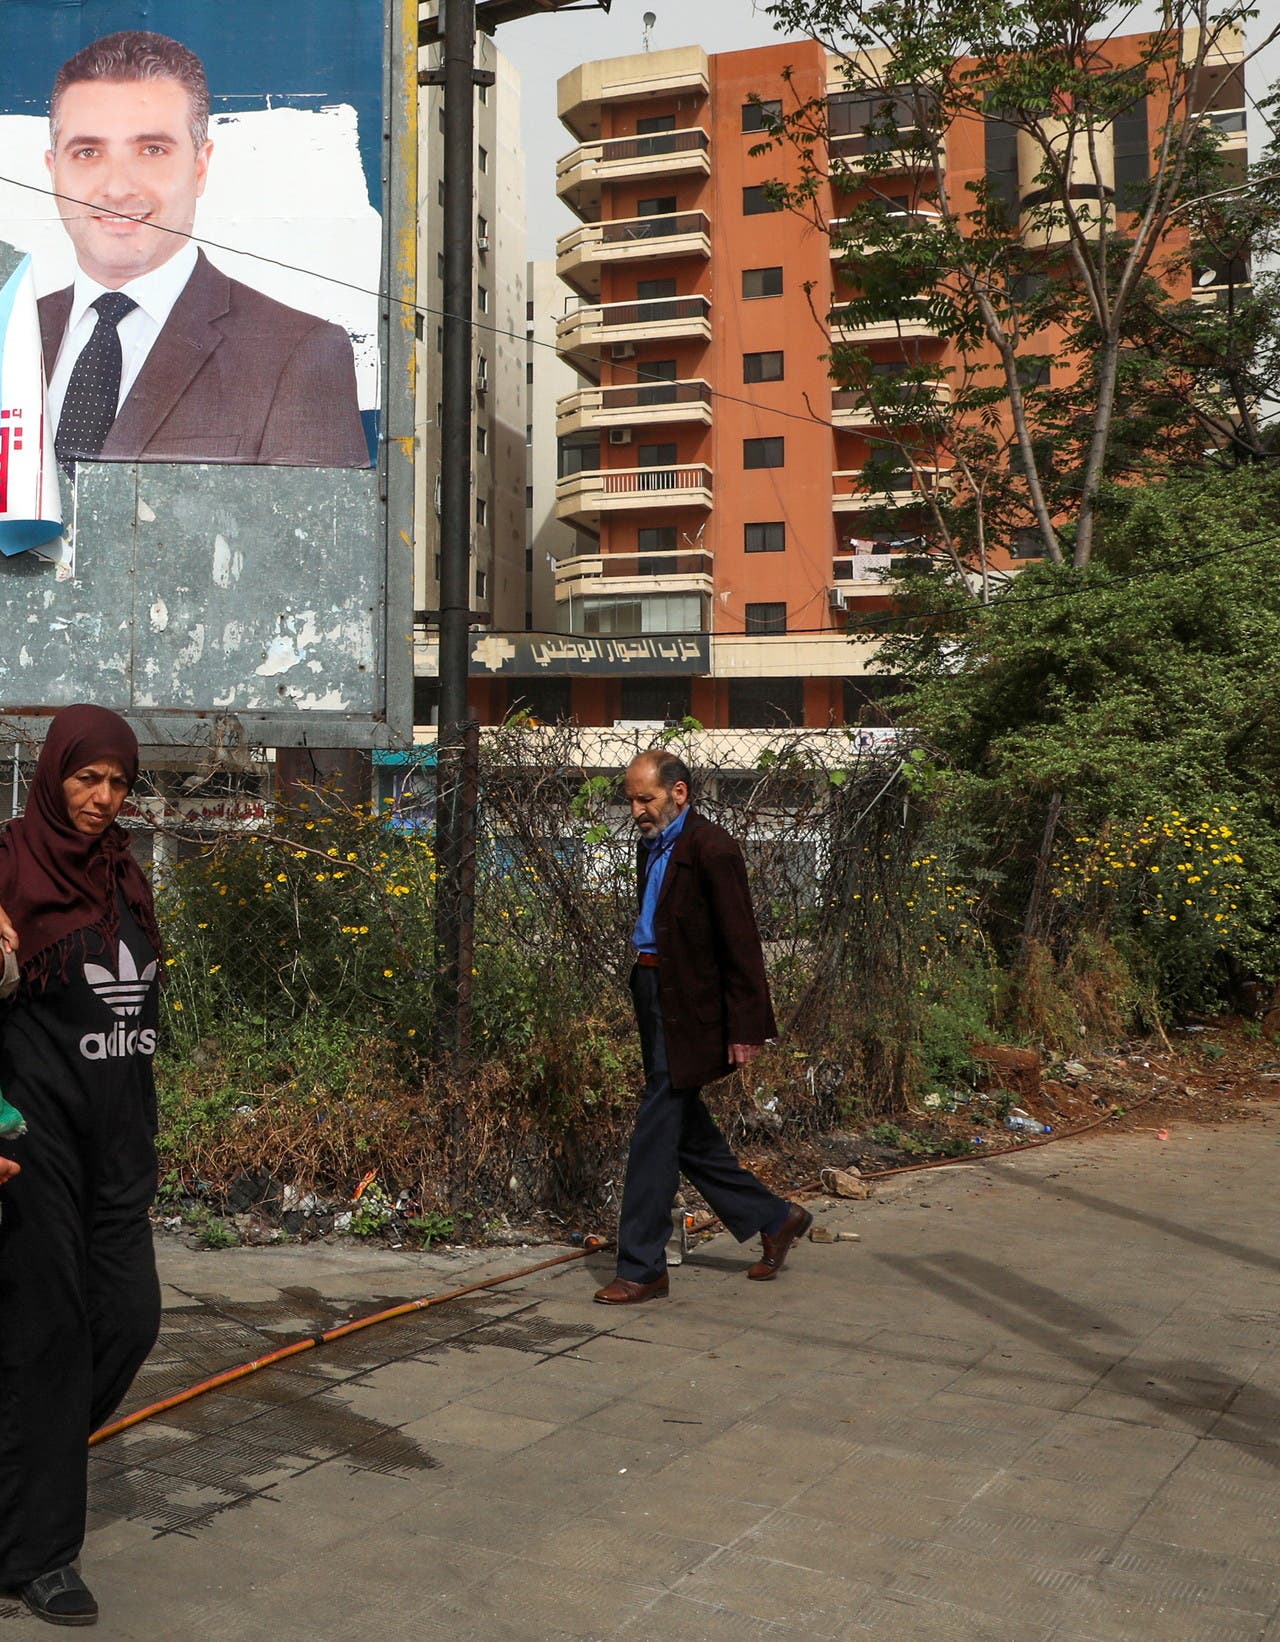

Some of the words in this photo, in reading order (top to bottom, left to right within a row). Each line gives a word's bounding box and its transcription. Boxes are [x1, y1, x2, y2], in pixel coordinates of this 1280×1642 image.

[530, 639, 604, 667] الوطني
[606, 640, 658, 663] الحوار
[658, 639, 701, 662] حزب
[79, 1021, 157, 1061] adis
